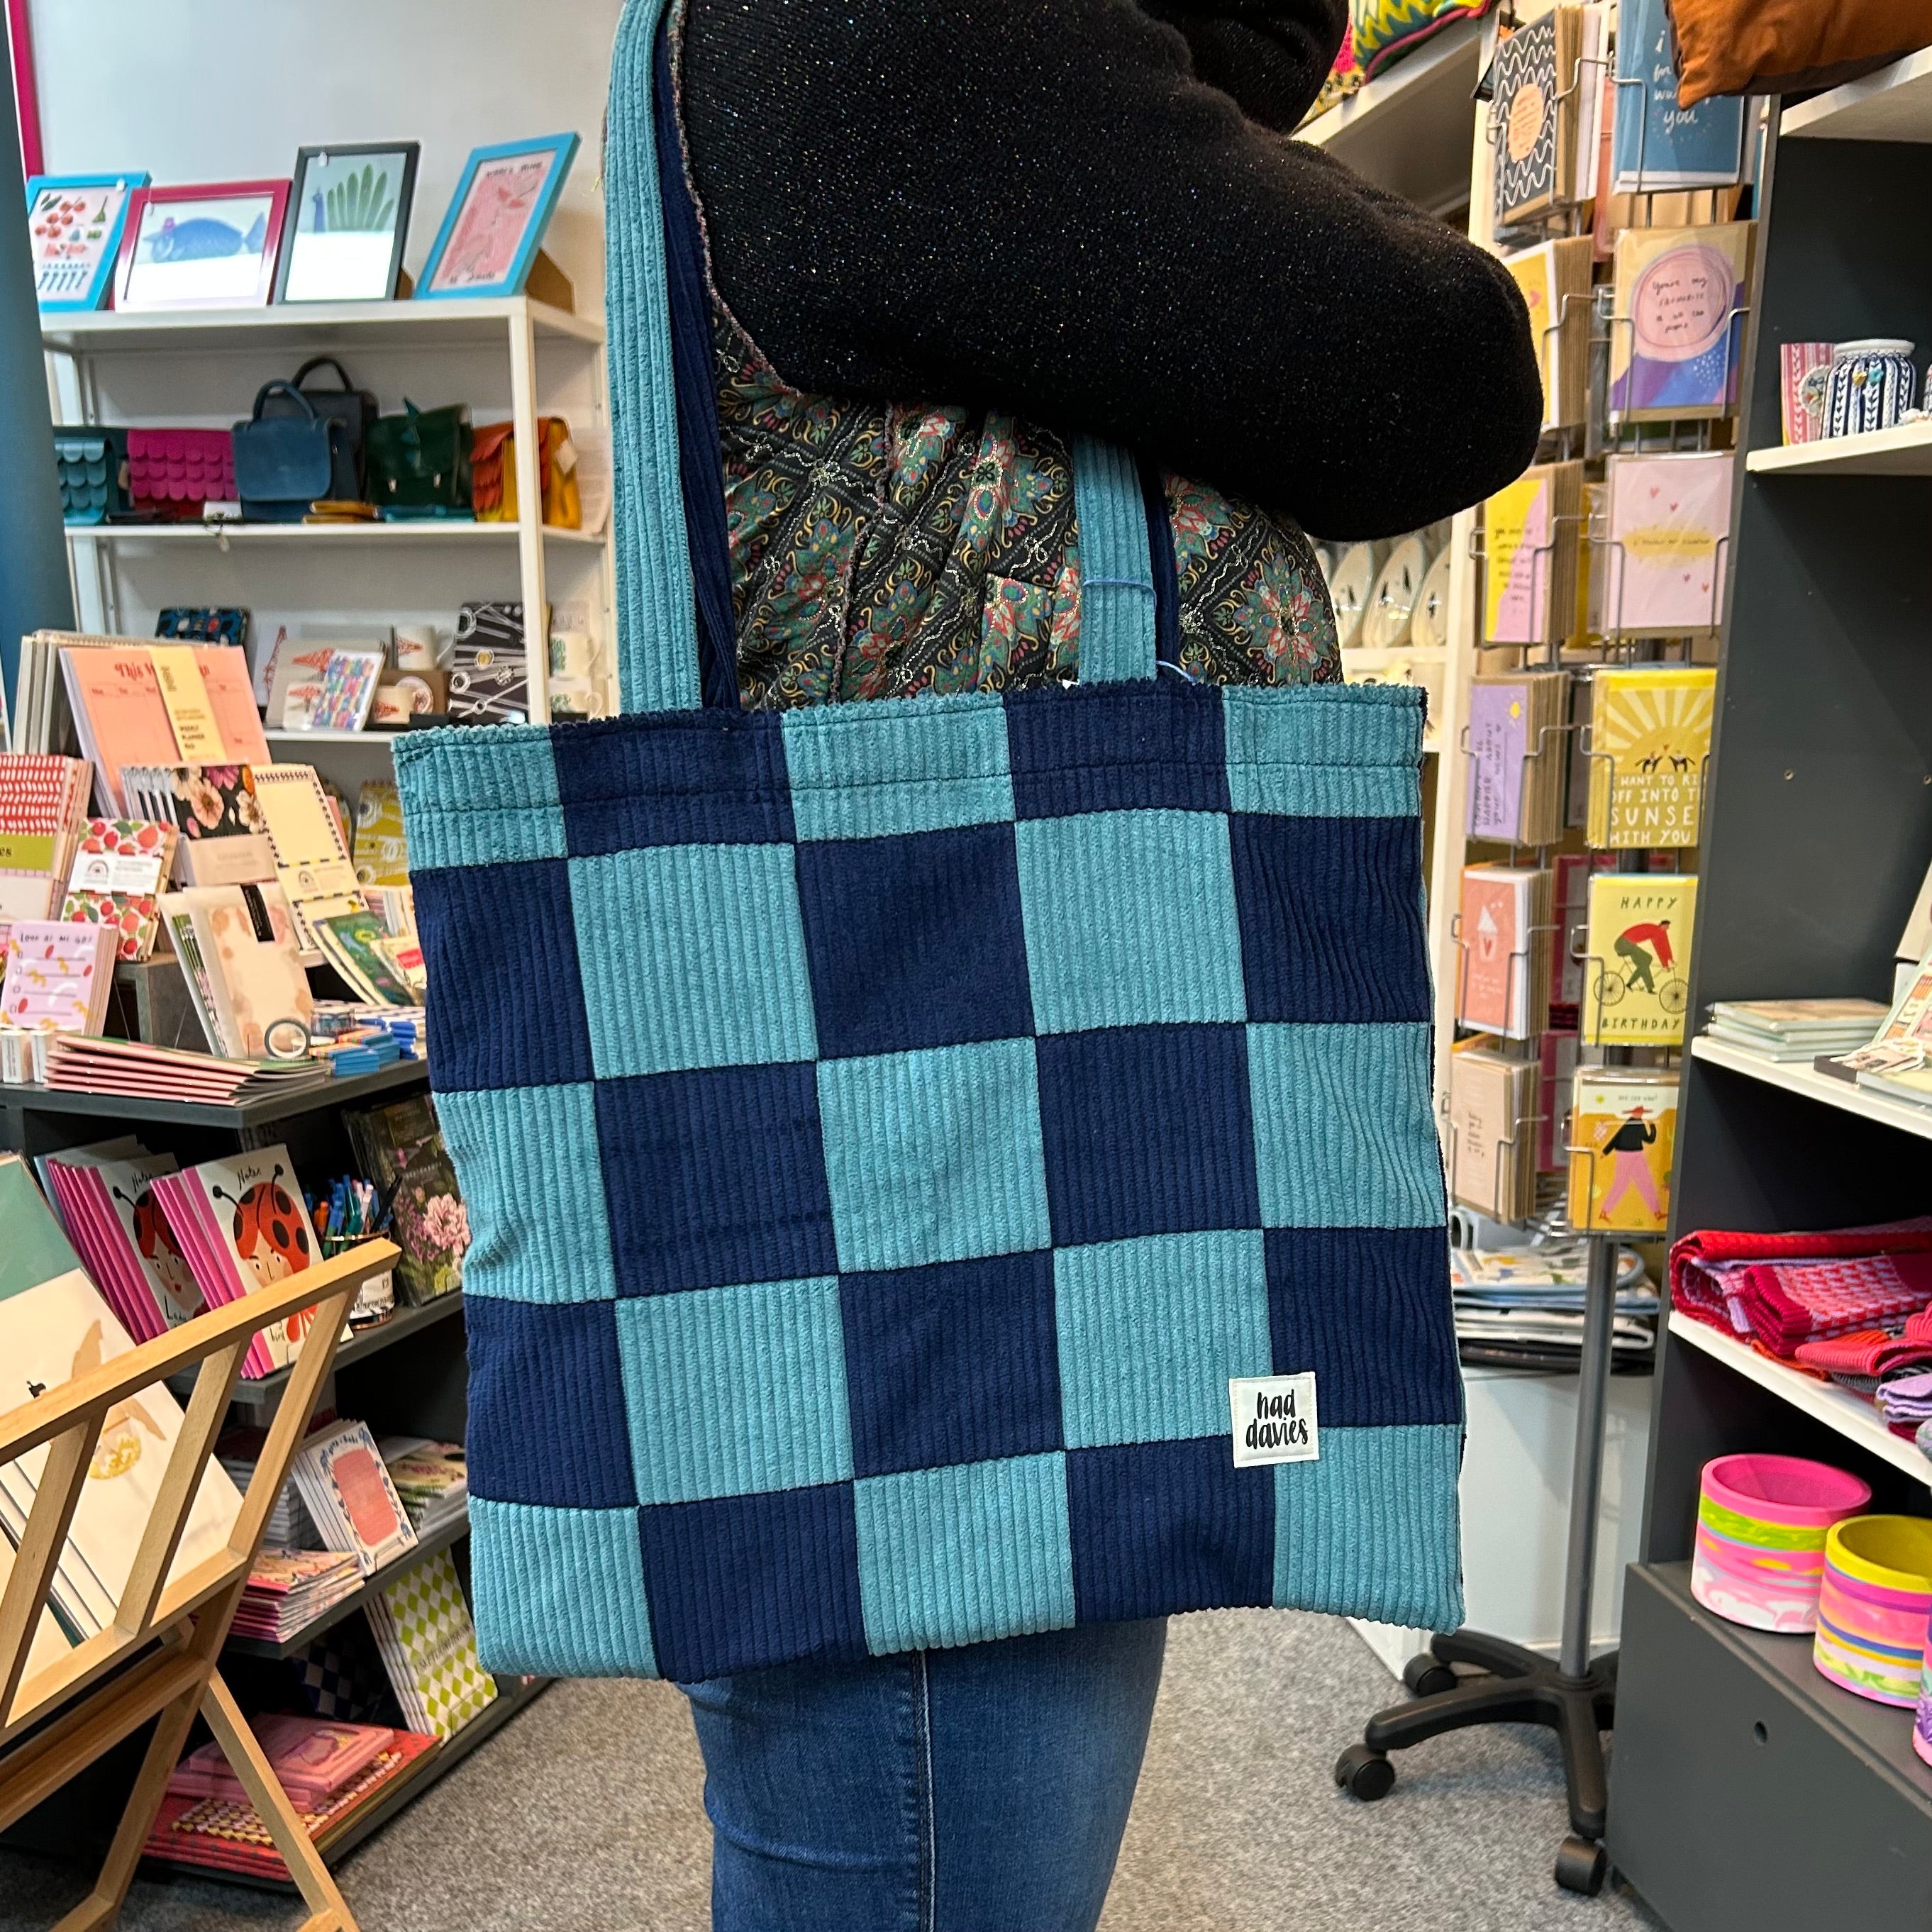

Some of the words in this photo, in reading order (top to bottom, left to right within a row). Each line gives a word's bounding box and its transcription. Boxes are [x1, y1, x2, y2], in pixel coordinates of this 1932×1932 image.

[1663, 108, 1699, 134] you
[1621, 776, 1653, 787] WANT
[1660, 774, 1675, 787] TO
[1640, 787, 1680, 803] INTO
[1611, 805, 1694, 826] SUNSE
[1610, 831, 1651, 845] WITH
[1660, 828, 1691, 845] YOU
[1621, 896, 1677, 909] HAPPY
[1601, 1017, 1681, 1029] BIRTHDAY
[238, 1167, 262, 1190] Notes
[1245, 1416, 1309, 1450] davies
